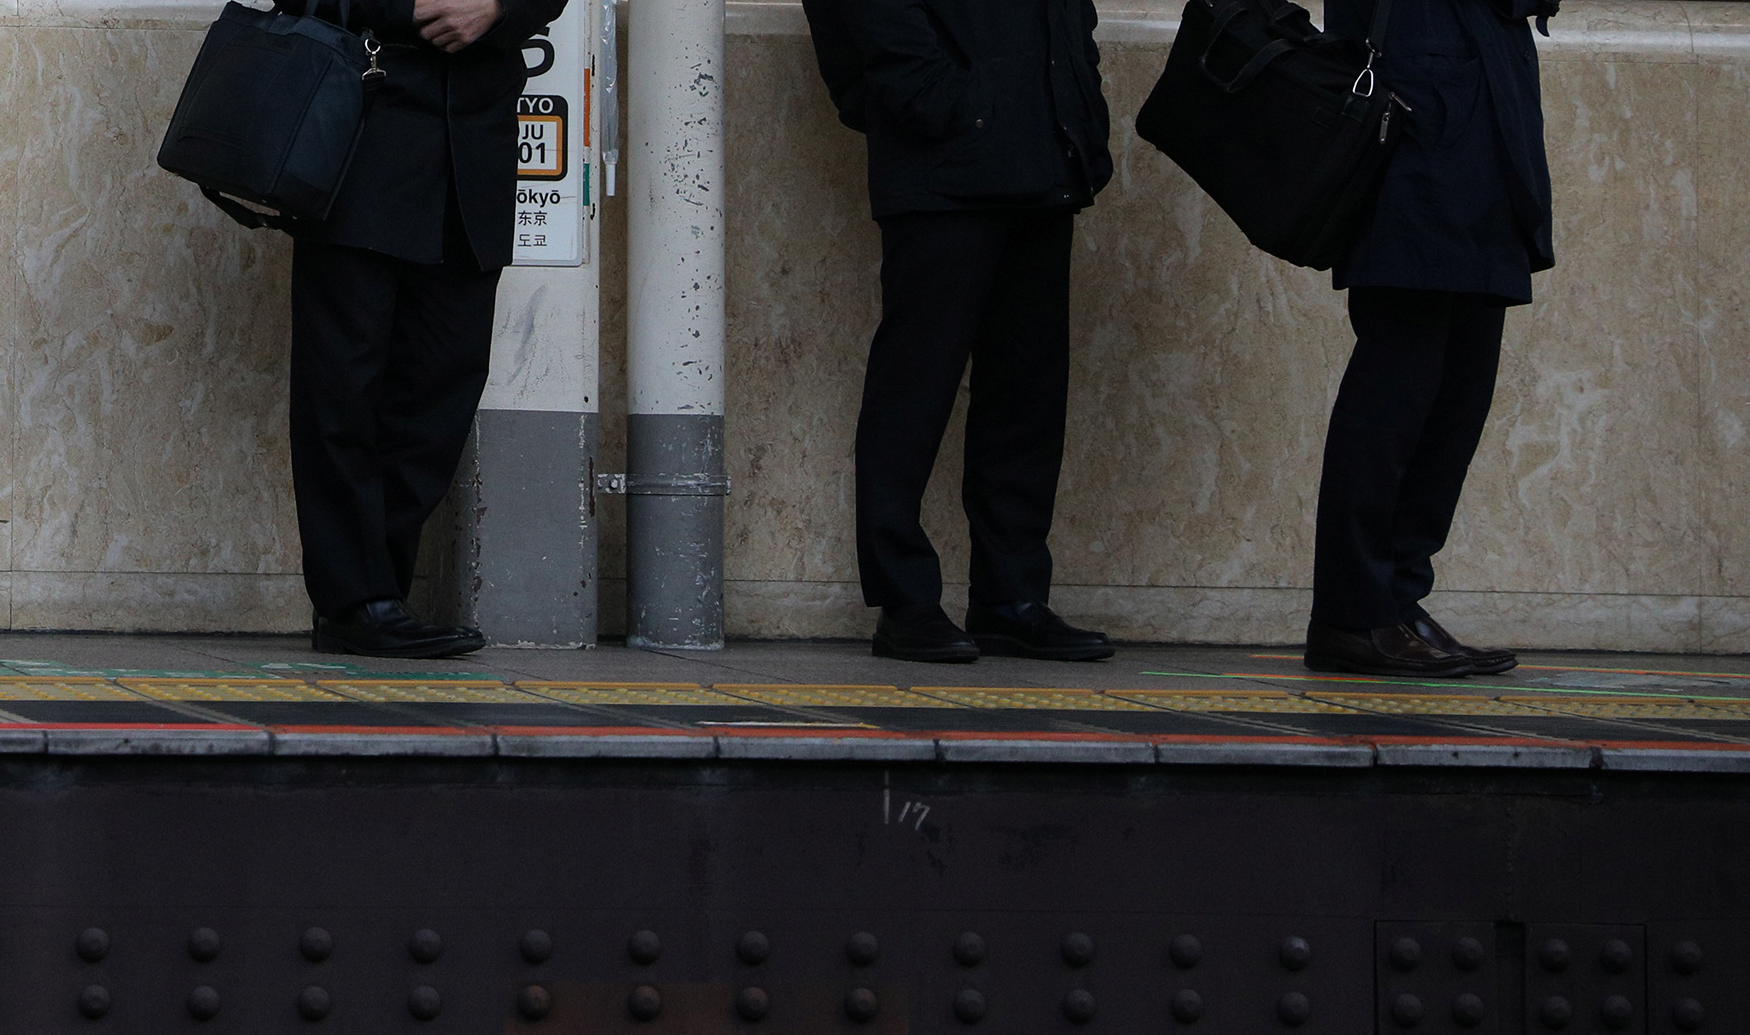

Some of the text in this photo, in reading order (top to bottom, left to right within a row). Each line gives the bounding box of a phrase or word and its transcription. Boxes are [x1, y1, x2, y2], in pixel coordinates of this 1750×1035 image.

[521, 124, 544, 140] JU
[518, 142, 546, 164] 01
[516, 189, 561, 208] ōkyō
[517, 210, 548, 226] 东京
[517, 233, 548, 247] 도쿄
